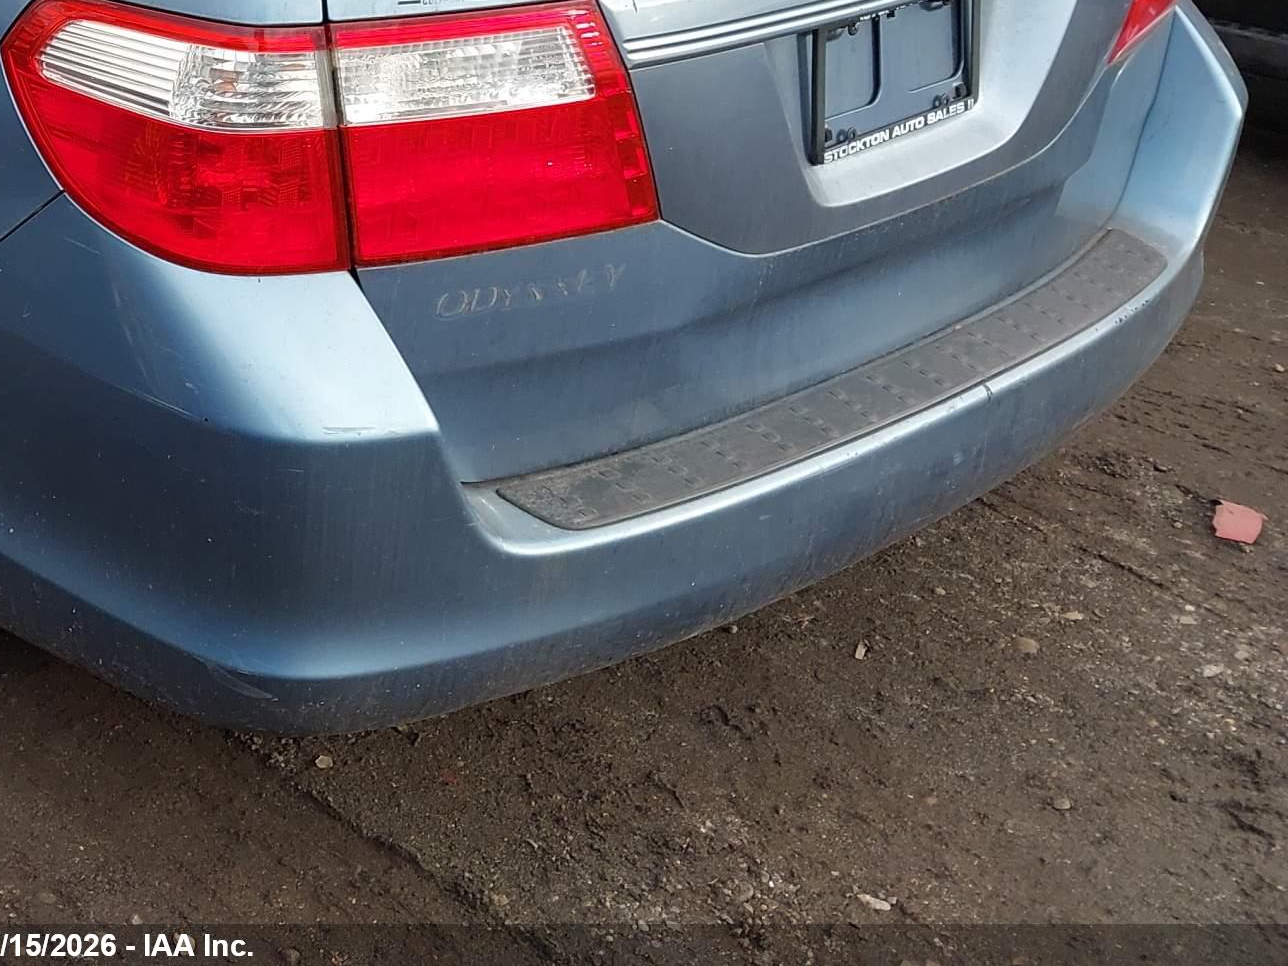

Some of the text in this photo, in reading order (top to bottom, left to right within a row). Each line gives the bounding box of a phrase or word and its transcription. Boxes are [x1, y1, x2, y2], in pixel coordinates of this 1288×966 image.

[824, 130, 890, 164] STOCKTON
[892, 116, 925, 138] AUTO
[927, 101, 964, 125] SALES
